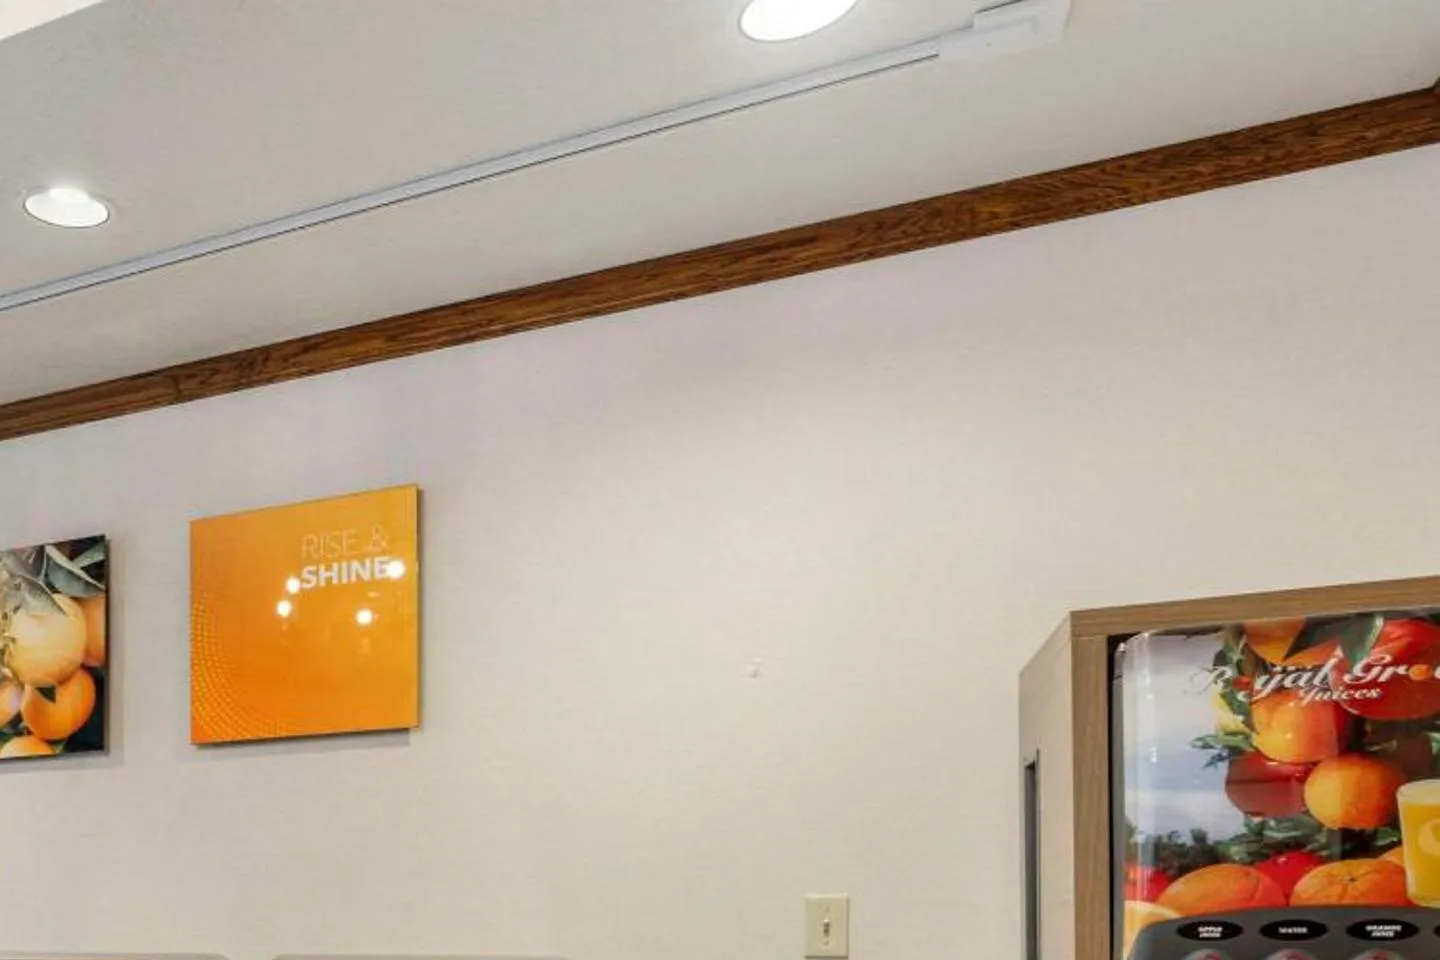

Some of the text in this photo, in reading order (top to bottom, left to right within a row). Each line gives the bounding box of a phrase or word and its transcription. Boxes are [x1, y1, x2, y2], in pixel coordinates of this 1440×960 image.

[302, 522, 389, 559] RISE &
[300, 556, 392, 589] SHINE
[1343, 654, 1440, 684] Gro
